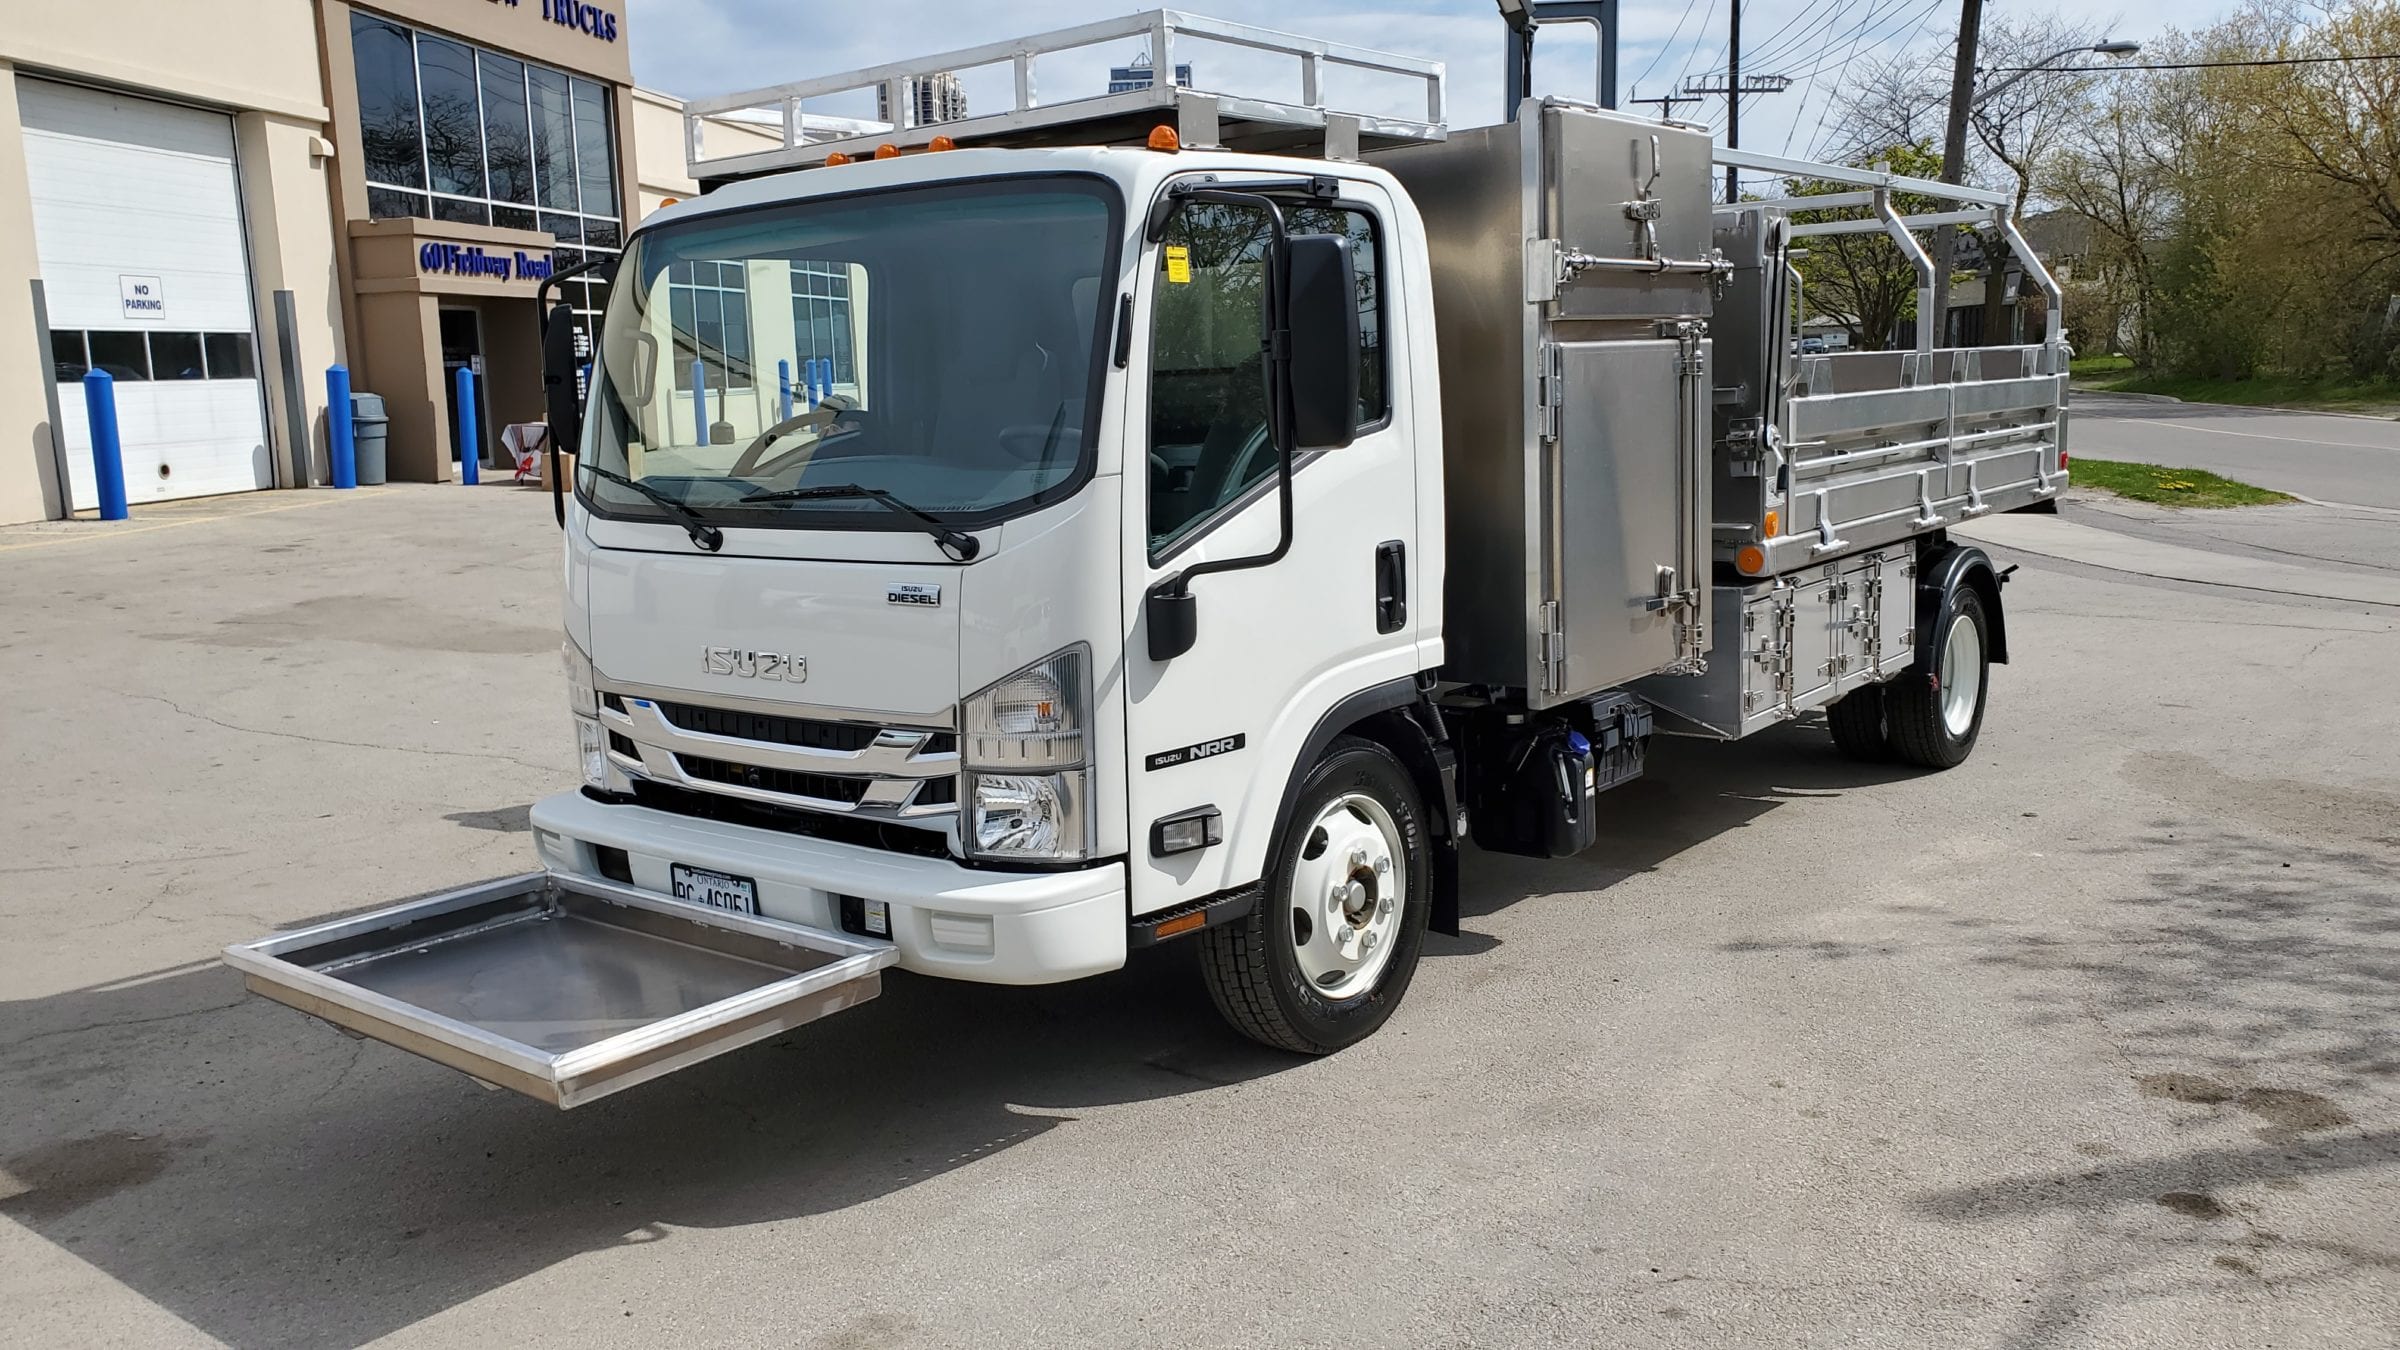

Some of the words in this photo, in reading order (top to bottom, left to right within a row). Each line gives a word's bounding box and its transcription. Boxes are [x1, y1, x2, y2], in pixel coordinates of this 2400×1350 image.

[420, 243, 442, 273] 60
[442, 244, 512, 283] Fieldway
[514, 251, 553, 281] Road
[134, 284, 149, 296] NO
[125, 298, 162, 311] PARKING
[901, 585, 923, 593] ISUZU
[887, 593, 936, 605] DIESEL
[702, 645, 807, 684] ISUZU
[1154, 753, 1182, 766] ISUZU
[1189, 738, 1235, 760] NRR
